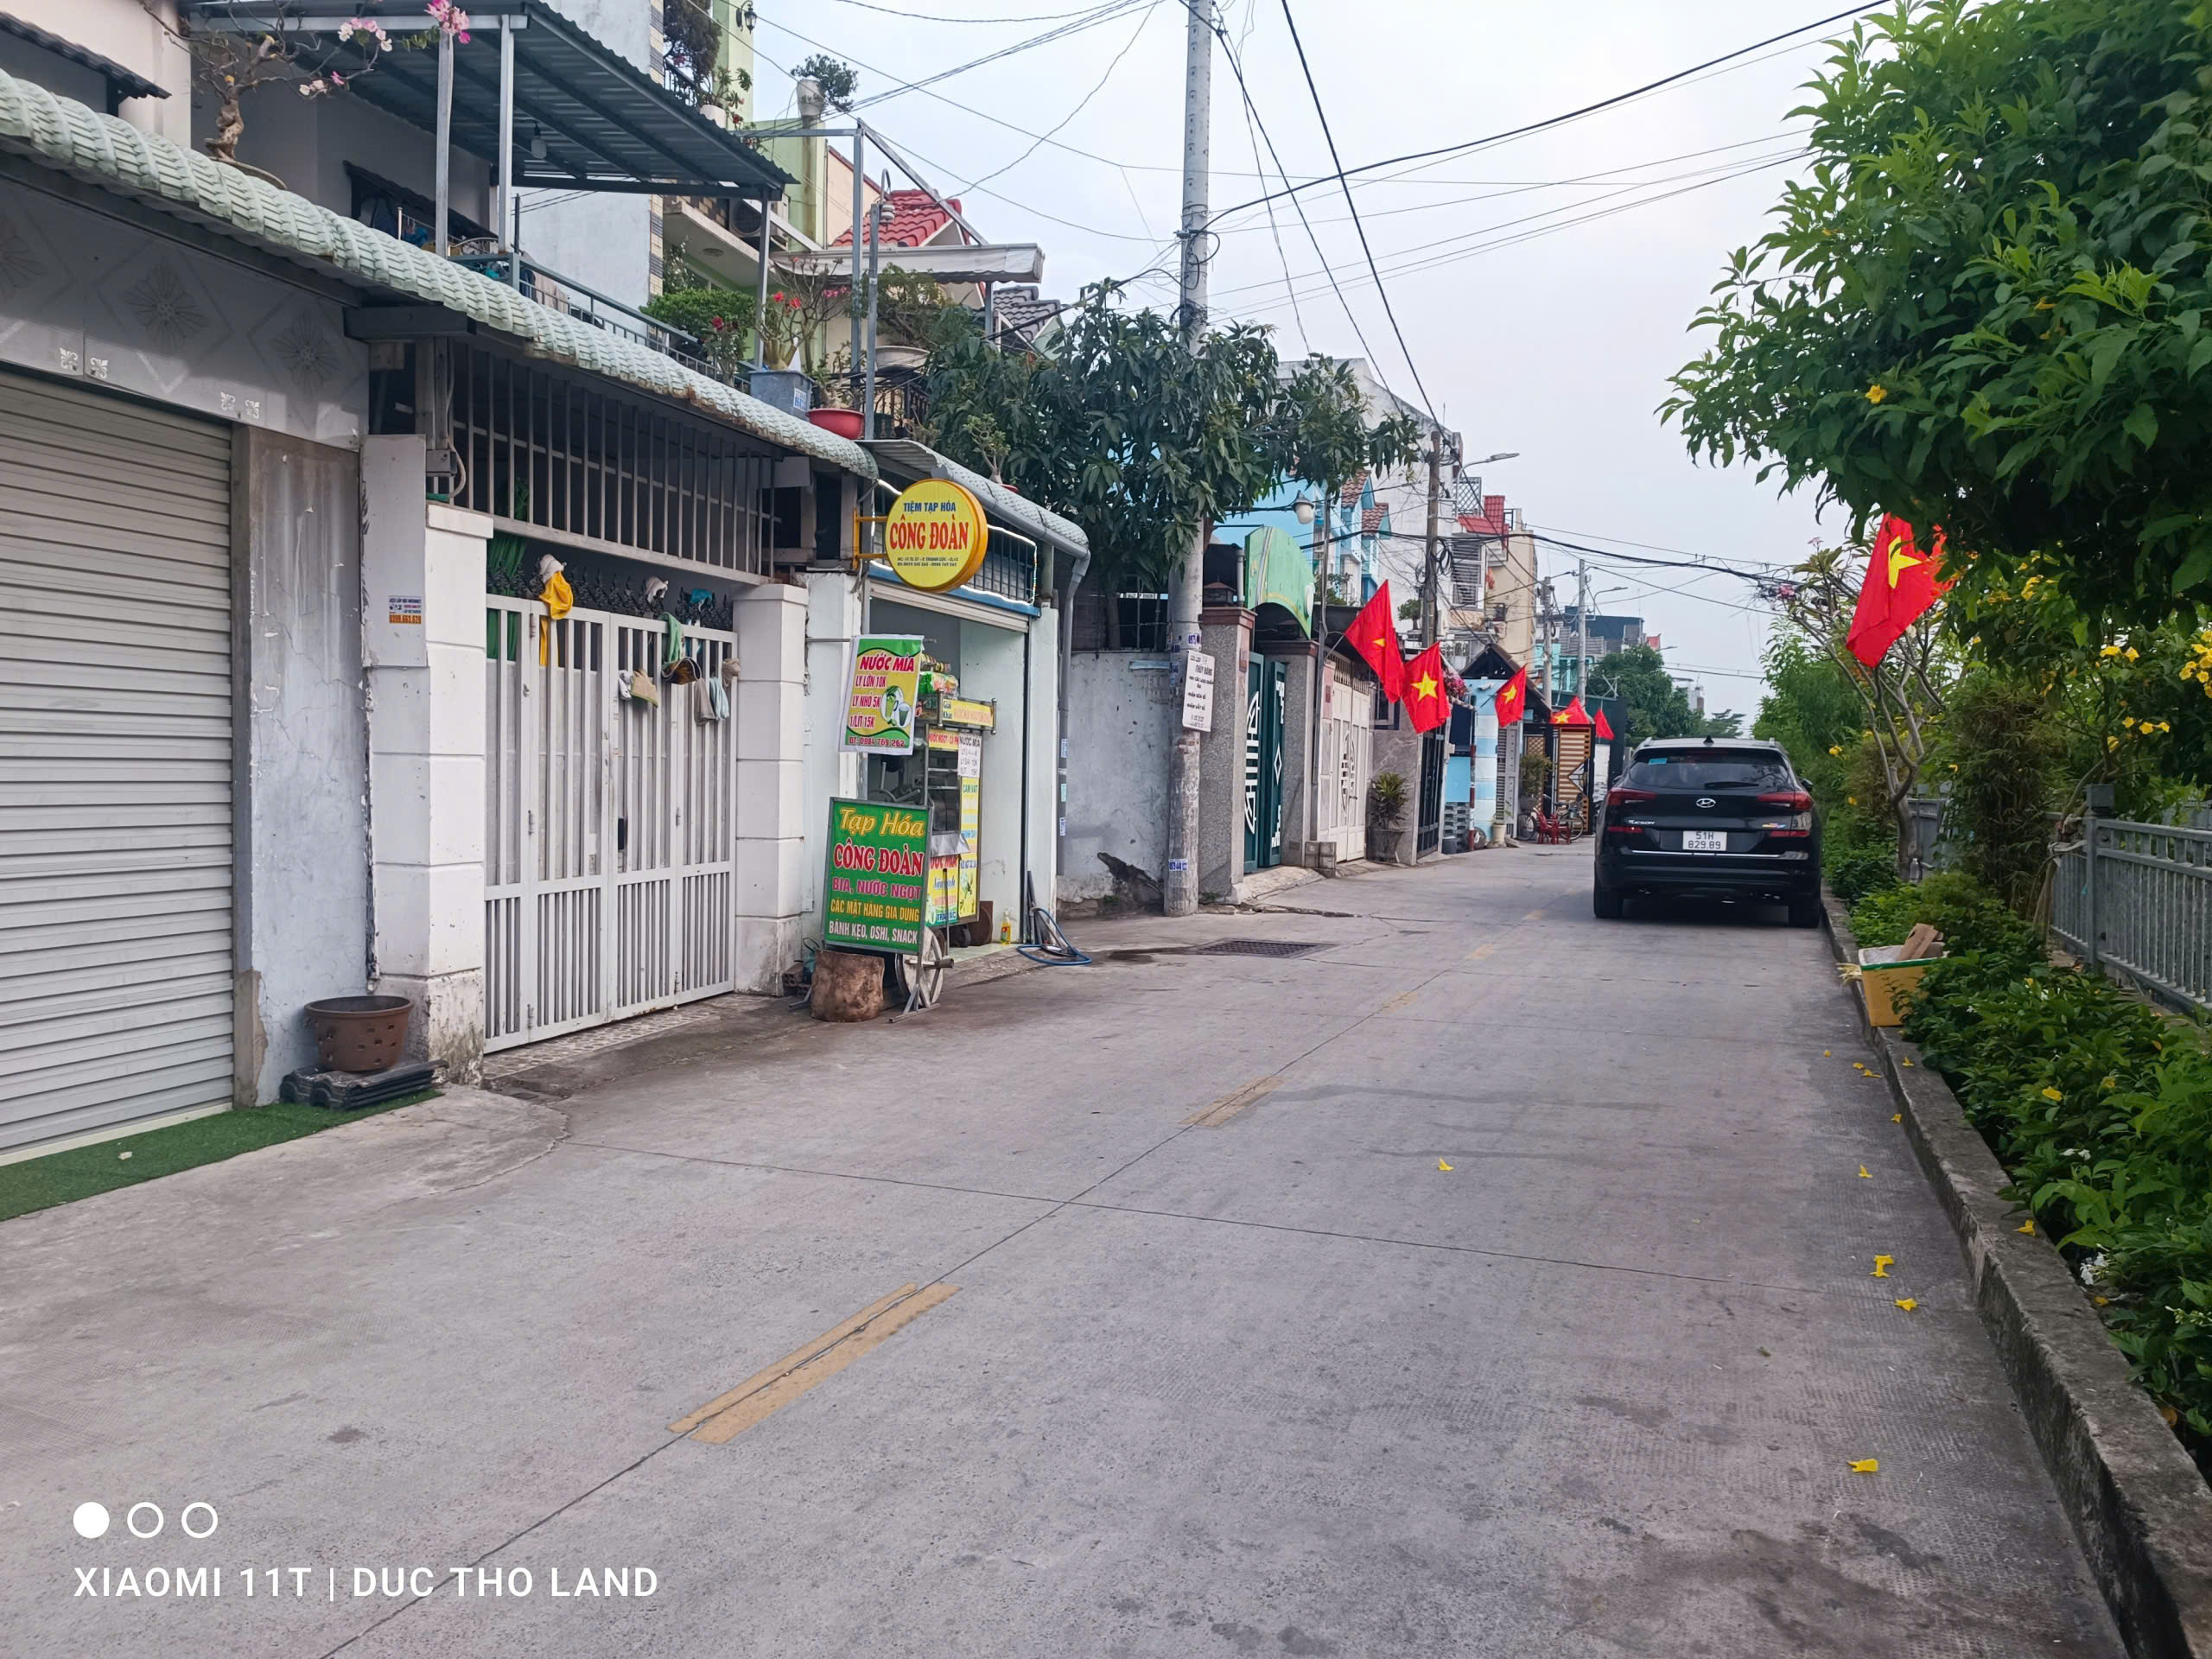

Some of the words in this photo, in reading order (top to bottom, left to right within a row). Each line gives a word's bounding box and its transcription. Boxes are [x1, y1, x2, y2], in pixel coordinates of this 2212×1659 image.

[903, 499, 922, 515] TIỆM
[924, 502, 939, 514] TẠP
[890, 513, 926, 550] CÔNG
[929, 513, 969, 550] ĐOÀN
[859, 652, 892, 671] NƯỚC
[893, 653, 915, 672] MÍA
[855, 676, 863, 687] LY
[875, 676, 886, 687] 10K
[852, 695, 859, 706] LY
[873, 697, 881, 708] 5K
[864, 716, 875, 728] 15K
[840, 807, 876, 836] Tạp
[880, 810, 925, 837] Hóa
[1688, 841, 1721, 849] 829.89
[1696, 831, 1714, 840] 51H
[833, 837, 875, 871] CÔNG
[878, 843, 924, 877] ĐOÀN
[832, 877, 853, 895] BIA,
[857, 878, 888, 896] NƯỚC
[891, 884, 922, 903] NGỌT
[831, 897, 844, 913] CÁC
[864, 902, 883, 918] HÀNG
[885, 905, 898, 920] GIA
[900, 908, 919, 924] DỤNG
[829, 918, 849, 936] BÁNH
[852, 924, 867, 940] KẸO,
[870, 927, 889, 942] OSHI,
[892, 928, 918, 944] SNACK
